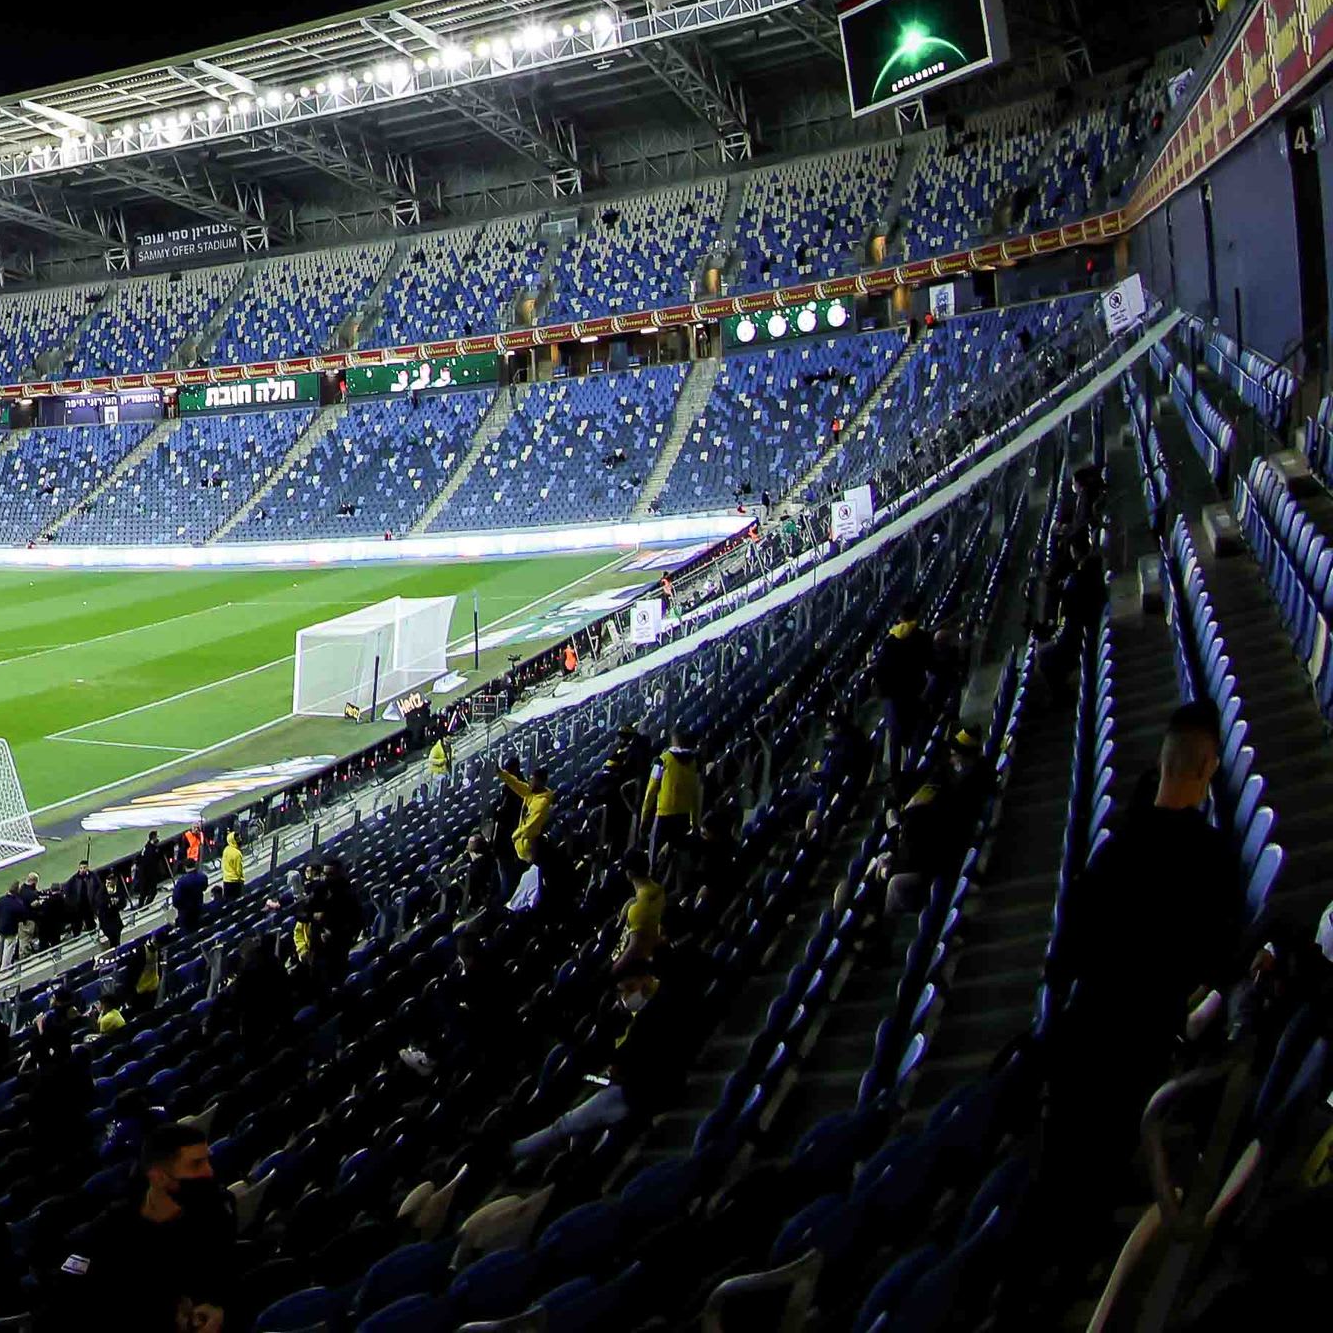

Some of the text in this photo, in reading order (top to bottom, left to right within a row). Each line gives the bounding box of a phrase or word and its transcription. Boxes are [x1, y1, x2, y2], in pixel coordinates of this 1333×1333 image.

[1294, 126, 1309, 154] 4
[138, 237, 237, 262] SAMMY OFER STADIUM
[205, 377, 296, 407] חלה חובת
[397, 692, 424, 718] Hertz
